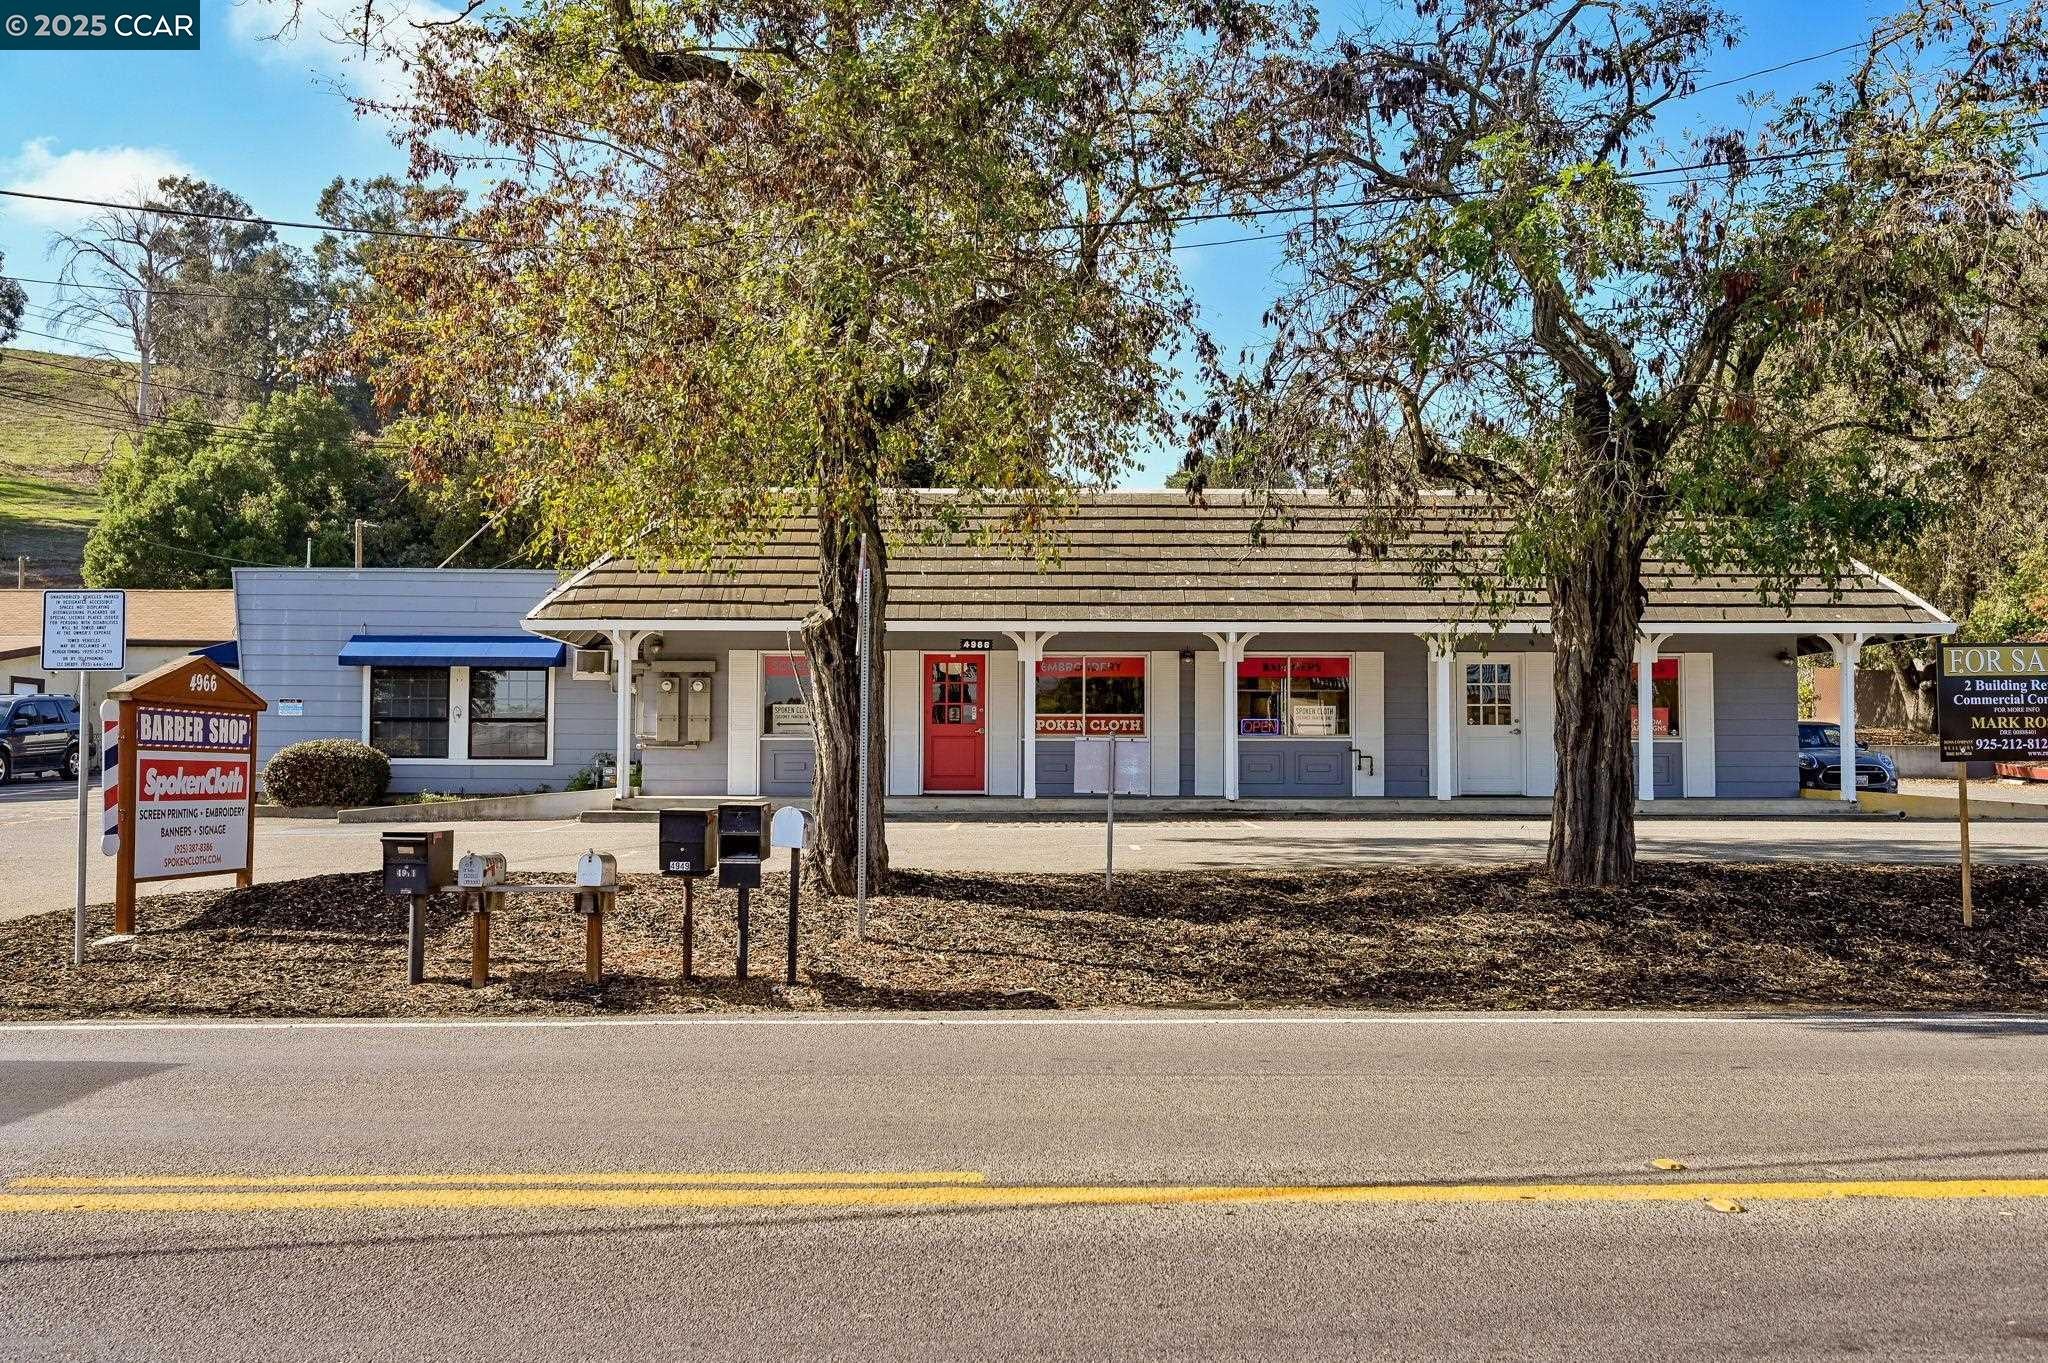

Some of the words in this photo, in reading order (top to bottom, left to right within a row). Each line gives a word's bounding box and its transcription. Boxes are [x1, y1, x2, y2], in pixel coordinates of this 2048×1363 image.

[1950, 649, 2003, 673] FOR
[2011, 648, 2046, 672] SA
[190, 674, 218, 692] 4966
[1964, 680, 1972, 691] 2
[1976, 680, 2028, 693] Building
[2030, 680, 2048, 690] Re
[1954, 694, 2024, 705] Commercial
[140, 713, 204, 742] BARBER
[208, 718, 248, 744] SHOP
[1035, 720, 1084, 731] POKEN
[1089, 720, 1142, 731] CLOTH
[1242, 722, 1276, 733] OPEN
[1971, 716, 2020, 728] MARK
[1976, 739, 2048, 750] 925-212-812
[144, 766, 244, 801] SpokenCloth
[139, 808, 166, 820] SCREEN
[167, 808, 198, 820] PRINTING
[205, 806, 246, 818] EMBROIDERY
[160, 826, 192, 838] BANNERS
[198, 824, 226, 836] SIGNAGE
[162, 854, 222, 868] SPOKENCLOTH.COM
[670, 862, 690, 870] 4949
